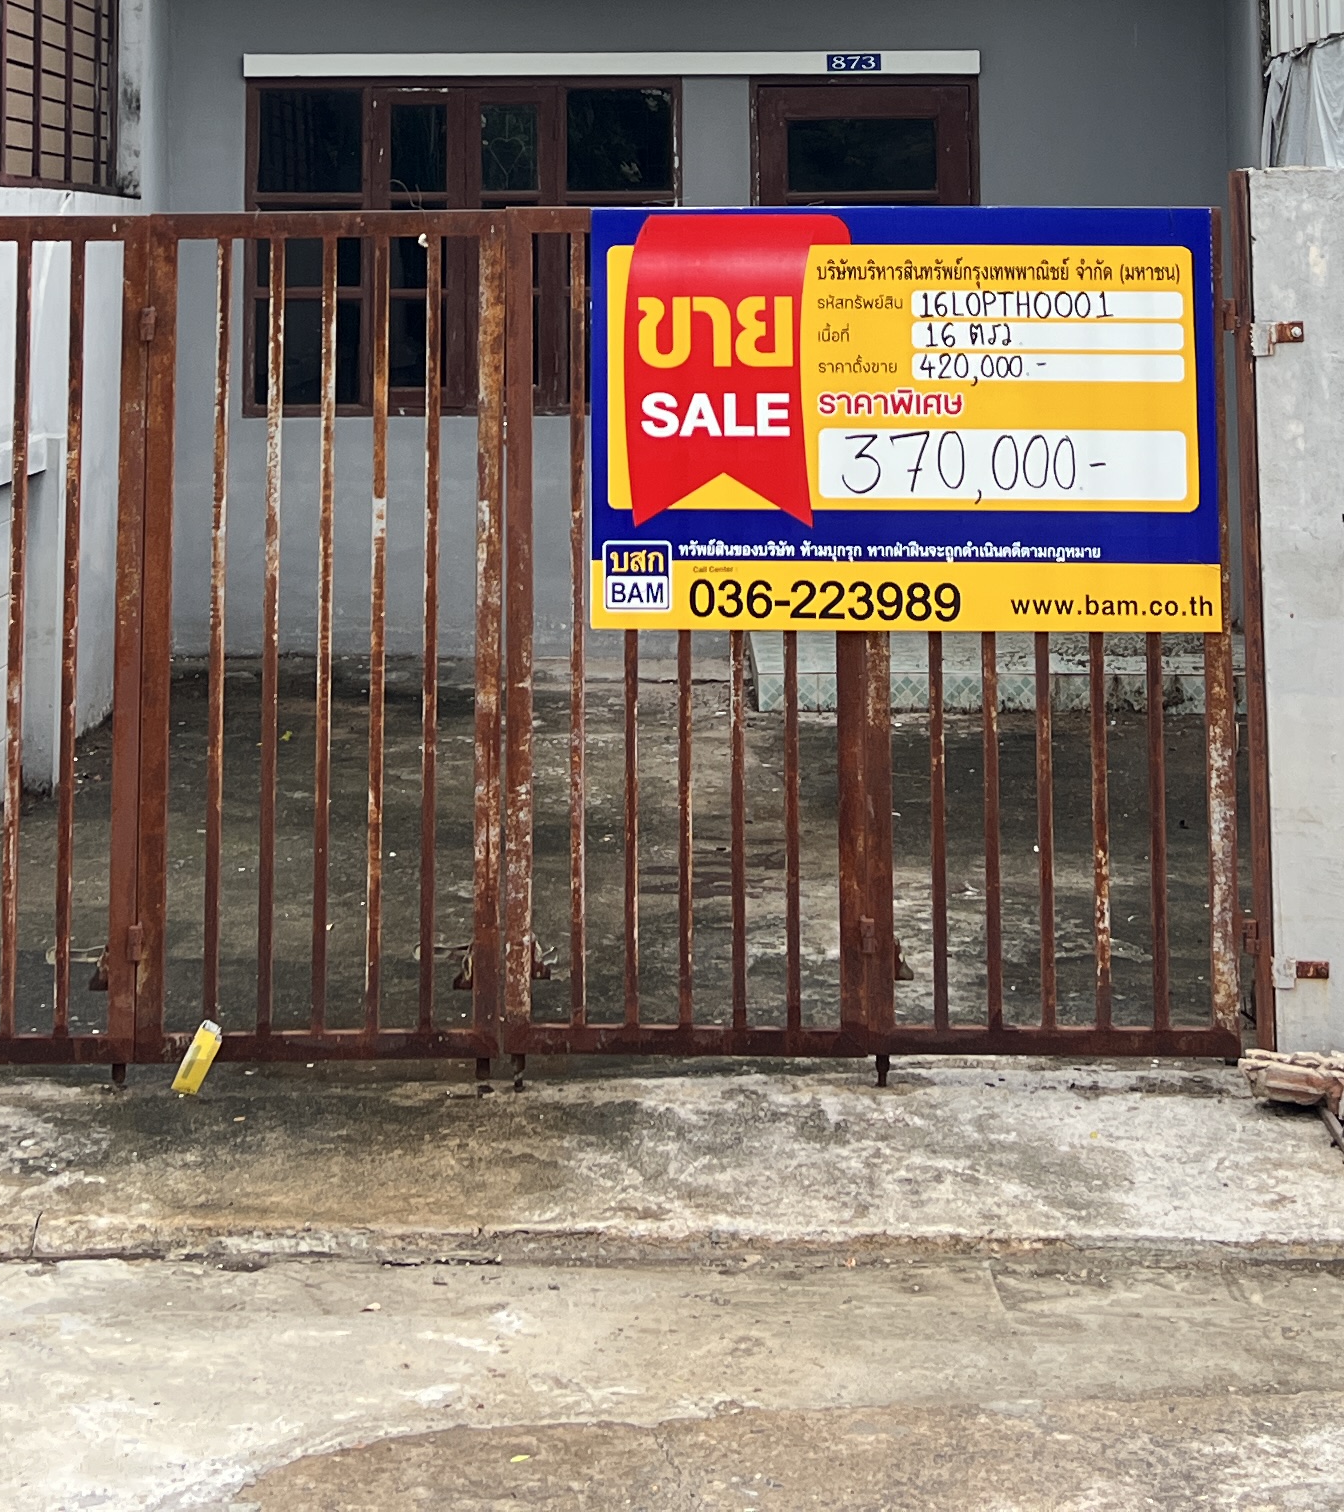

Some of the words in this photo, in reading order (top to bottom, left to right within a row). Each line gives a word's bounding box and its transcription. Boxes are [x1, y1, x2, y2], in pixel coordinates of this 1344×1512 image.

[832, 56, 876, 69] 873
[817, 257, 1069, 288] บริษัทบริหารสินทรัพย์กรุงเทพพาณิชย์
[1075, 258, 1113, 281] จำกัด
[1120, 263, 1180, 284] (มหาชน)
[818, 295, 903, 310] รหัสทรัพย์สิน
[637, 295, 794, 368] ขาย
[818, 323, 850, 342] เนื้อที่
[925, 322, 956, 348] 16
[818, 354, 898, 374] ราคาตั้งขาย
[818, 389, 963, 416] ราคาพิเศษ
[640, 392, 790, 438] SALE
[611, 550, 665, 574] บสก
[678, 539, 796, 558] ทรัพย์สินของบริษัท
[800, 539, 863, 563] ห้ามบุกรุก
[611, 582, 664, 604] BAM
[689, 578, 962, 623] 036-223989
[1010, 594, 1214, 618] www.bam.co.th
